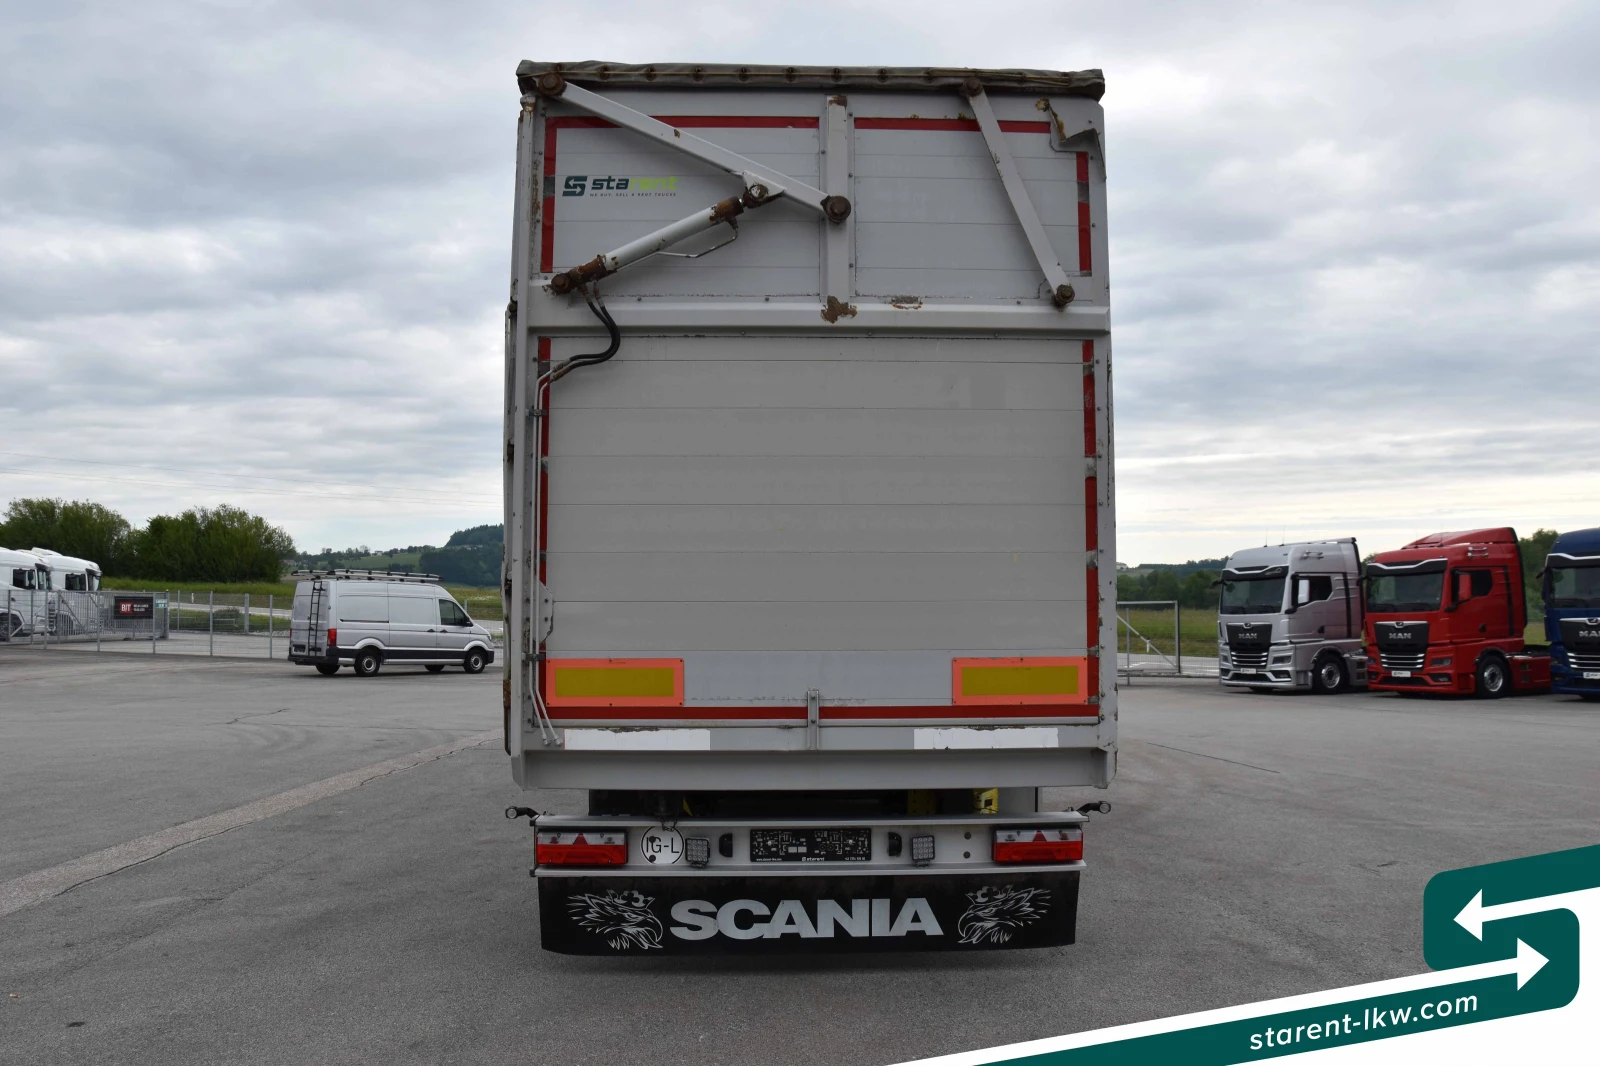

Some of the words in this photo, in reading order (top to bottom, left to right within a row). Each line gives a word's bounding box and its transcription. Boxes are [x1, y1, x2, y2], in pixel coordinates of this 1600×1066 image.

[591, 176, 679, 190] starent
[646, 836, 680, 854] IG-L
[669, 897, 944, 941] SCANIA
